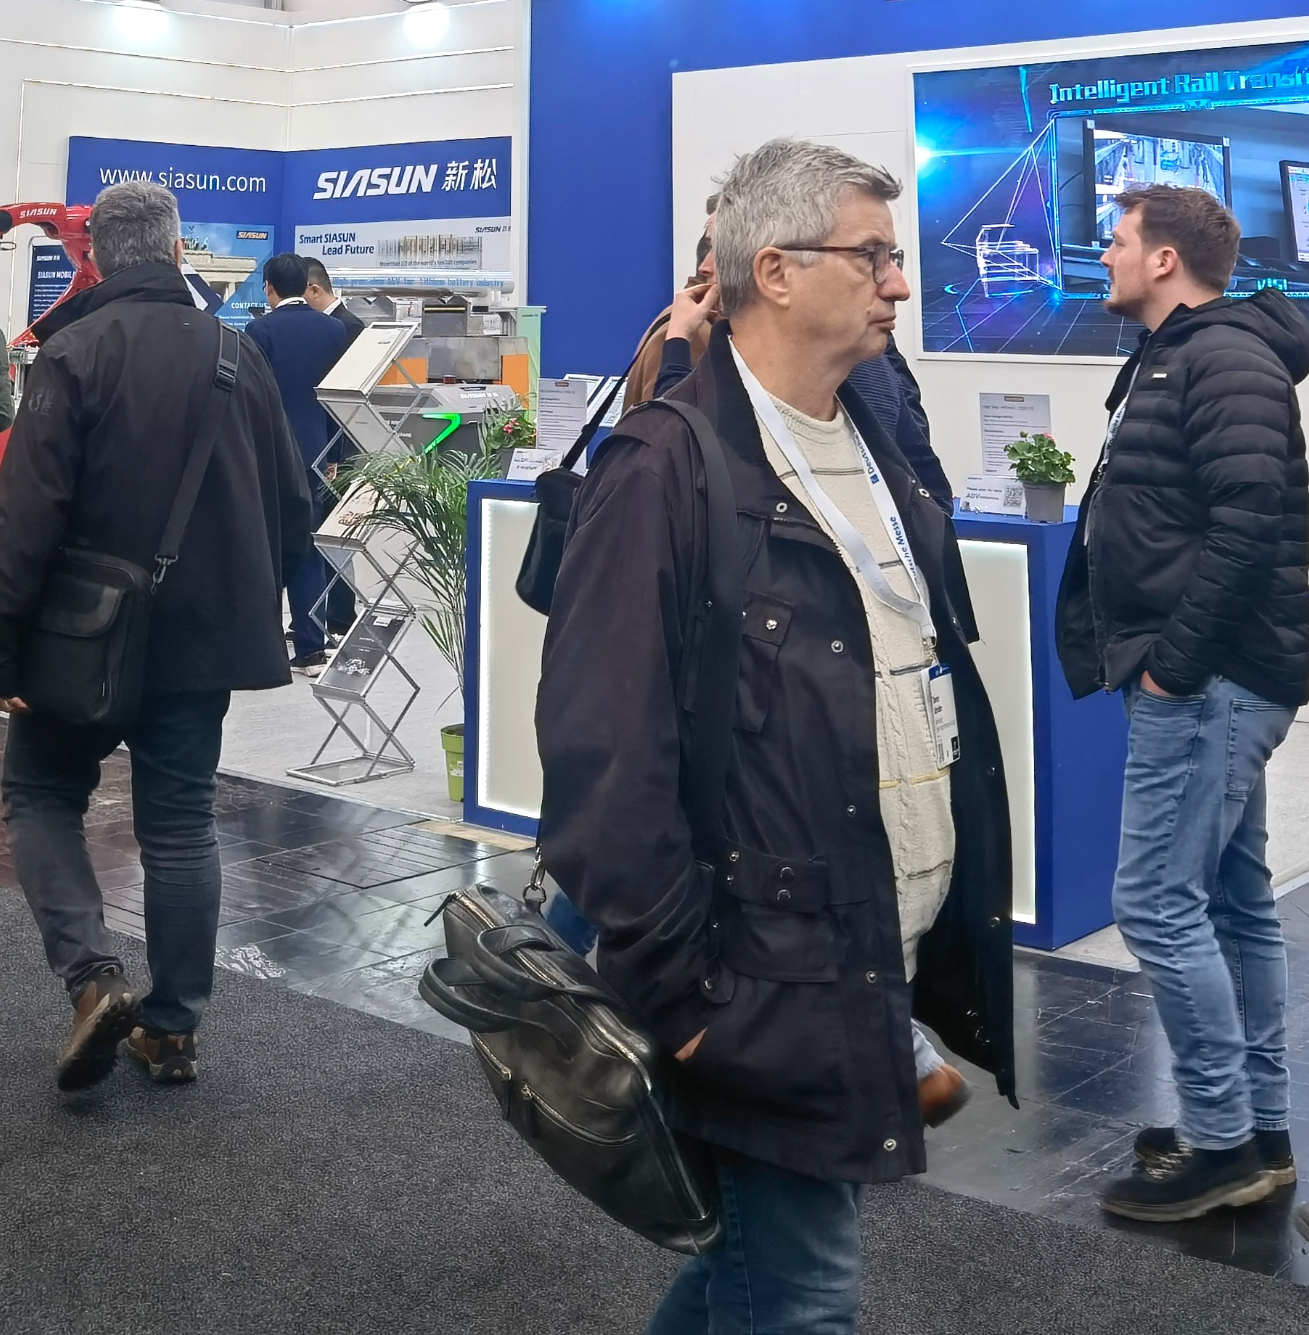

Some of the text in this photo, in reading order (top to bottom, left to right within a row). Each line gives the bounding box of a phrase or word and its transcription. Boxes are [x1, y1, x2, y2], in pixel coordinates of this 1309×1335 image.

[1049, 76, 1172, 105] Intelligent
[1174, 70, 1220, 95] Rail
[99, 166, 266, 193] wwwsiasun.com
[312, 158, 498, 200] SIASUN 新松
[19, 208, 58, 219] SIASUN
[237, 231, 268, 240] SIASUN
[299, 231, 356, 245] Smart SIASUN
[322, 243, 375, 256] Lead Future
[889, 516, 906, 546] Messe
